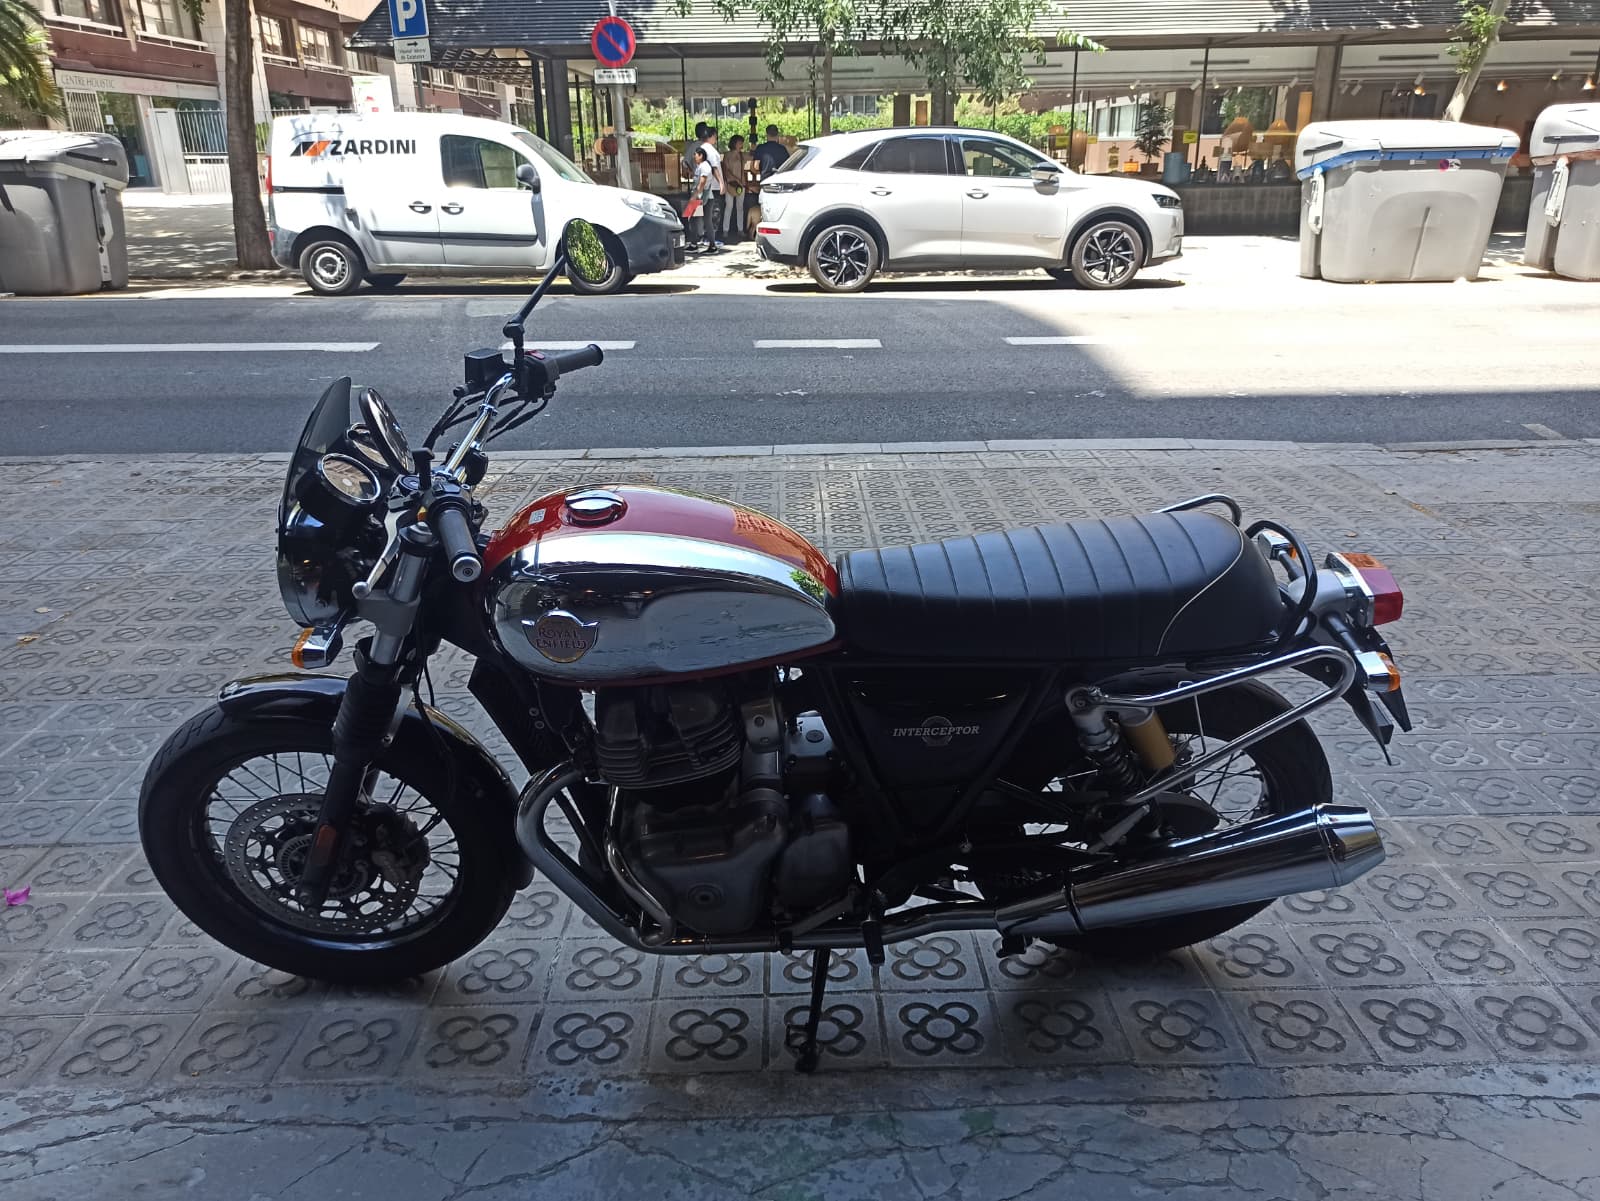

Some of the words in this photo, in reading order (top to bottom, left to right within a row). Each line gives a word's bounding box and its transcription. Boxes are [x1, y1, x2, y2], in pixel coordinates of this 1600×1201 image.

[395, 0, 417, 32] P
[61, 74, 85, 87] CENTRE
[330, 139, 416, 156] ZARDINI
[538, 628, 578, 639] ROYAL
[536, 639, 587, 650] ENFIELD
[892, 725, 980, 737] INTERCEPTOR
